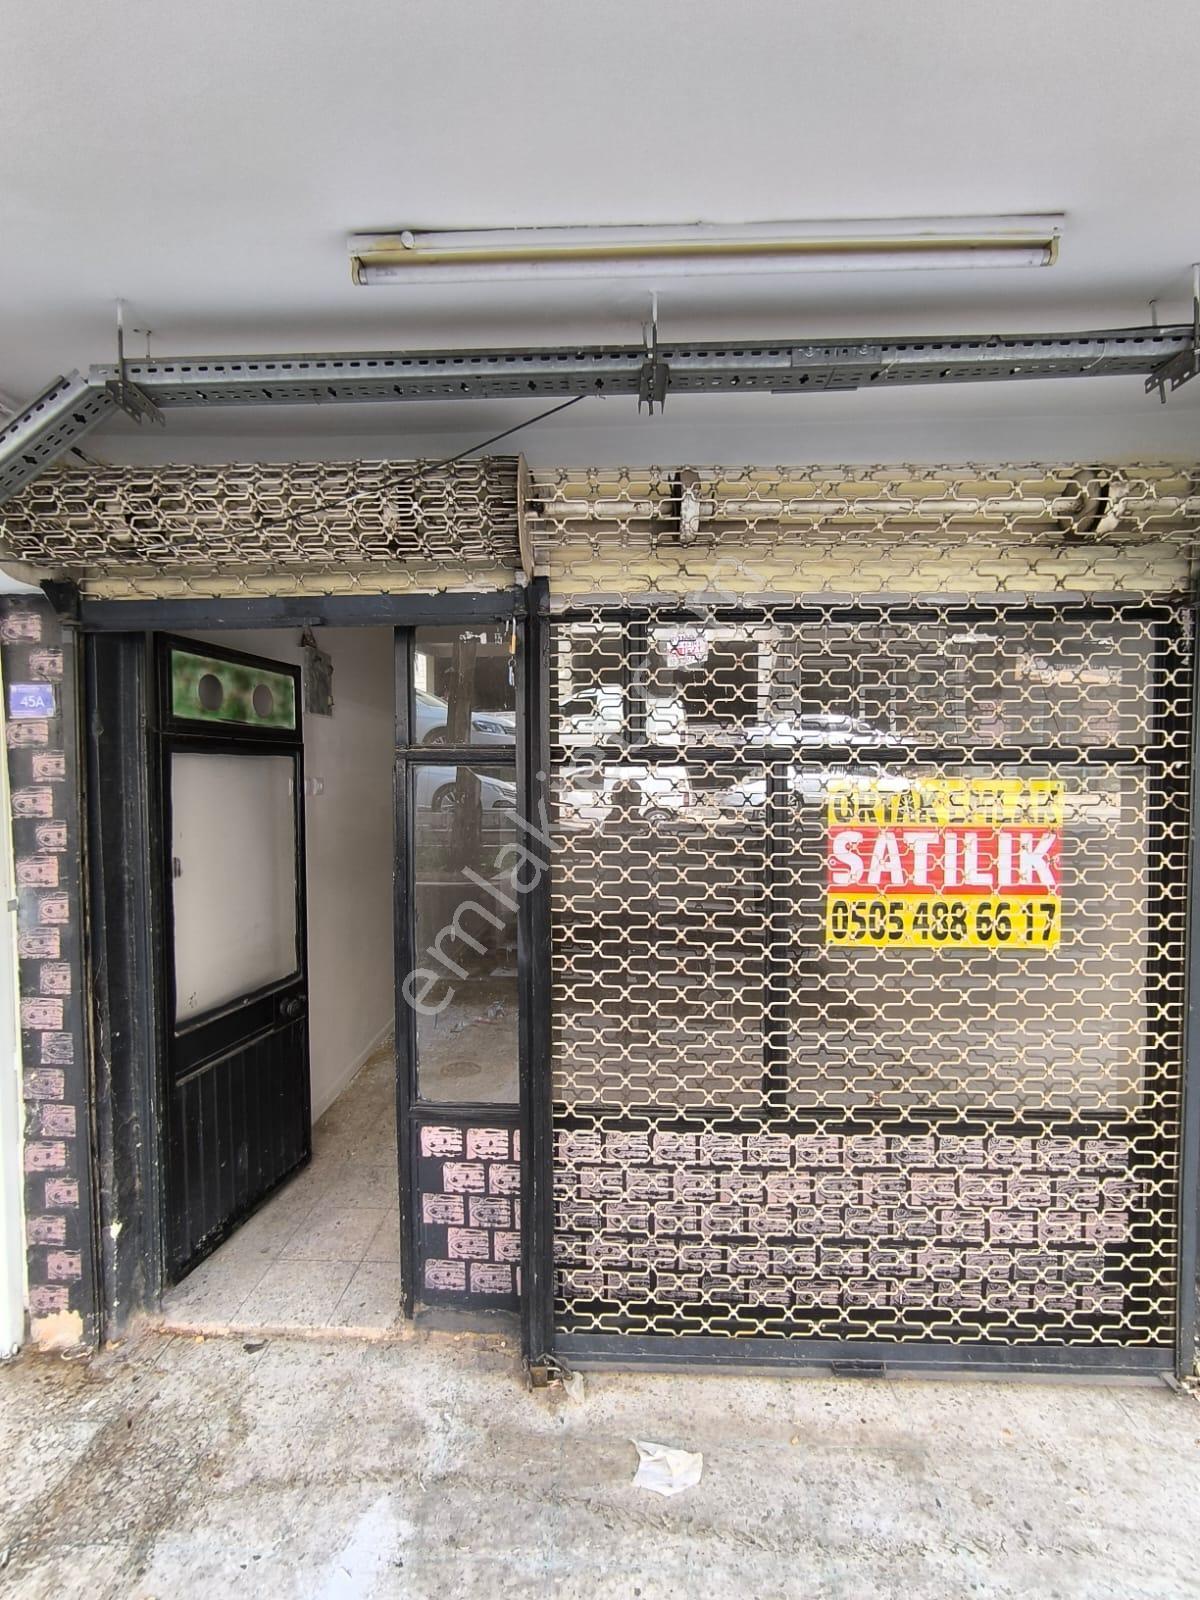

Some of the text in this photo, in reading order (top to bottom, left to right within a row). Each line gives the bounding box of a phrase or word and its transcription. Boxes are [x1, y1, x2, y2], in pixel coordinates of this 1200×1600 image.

[20, 695, 45, 708] 45A
[832, 831, 1057, 887] SATILIK
[831, 900, 1056, 942] 0505 488 66 17
